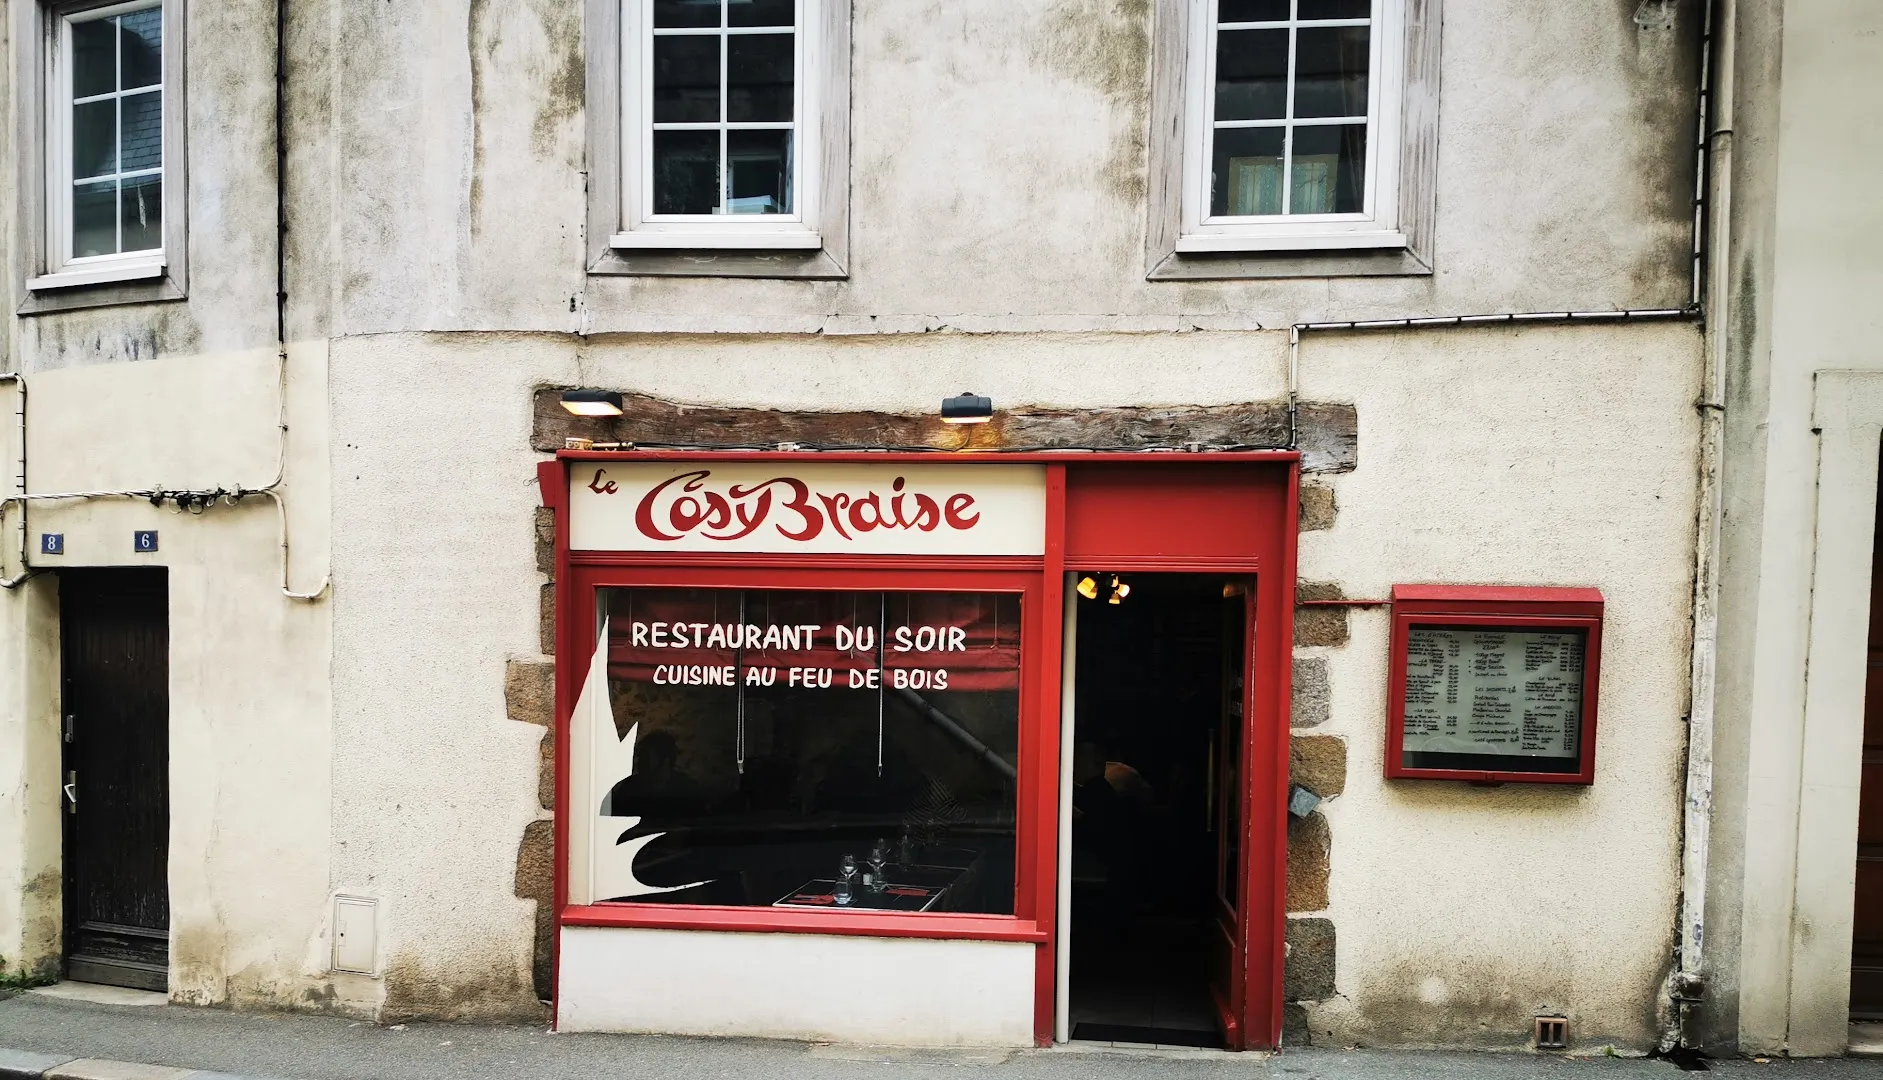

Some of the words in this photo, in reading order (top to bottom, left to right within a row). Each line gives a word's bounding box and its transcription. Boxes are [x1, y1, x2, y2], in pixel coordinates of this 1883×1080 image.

[588, 468, 619, 495] Le
[634, 470, 772, 541] Cosy
[770, 476, 980, 541] Braise
[47, 536, 56, 550] 8
[141, 533, 150, 548] 6
[632, 621, 821, 651] RESTAURANT
[835, 625, 874, 652] DU
[893, 625, 966, 652] SOIR
[653, 665, 736, 687] CUISINE
[745, 666, 777, 687] AU
[789, 667, 833, 689] FEU
[849, 668, 881, 689] DE
[893, 668, 948, 690] BOIS
